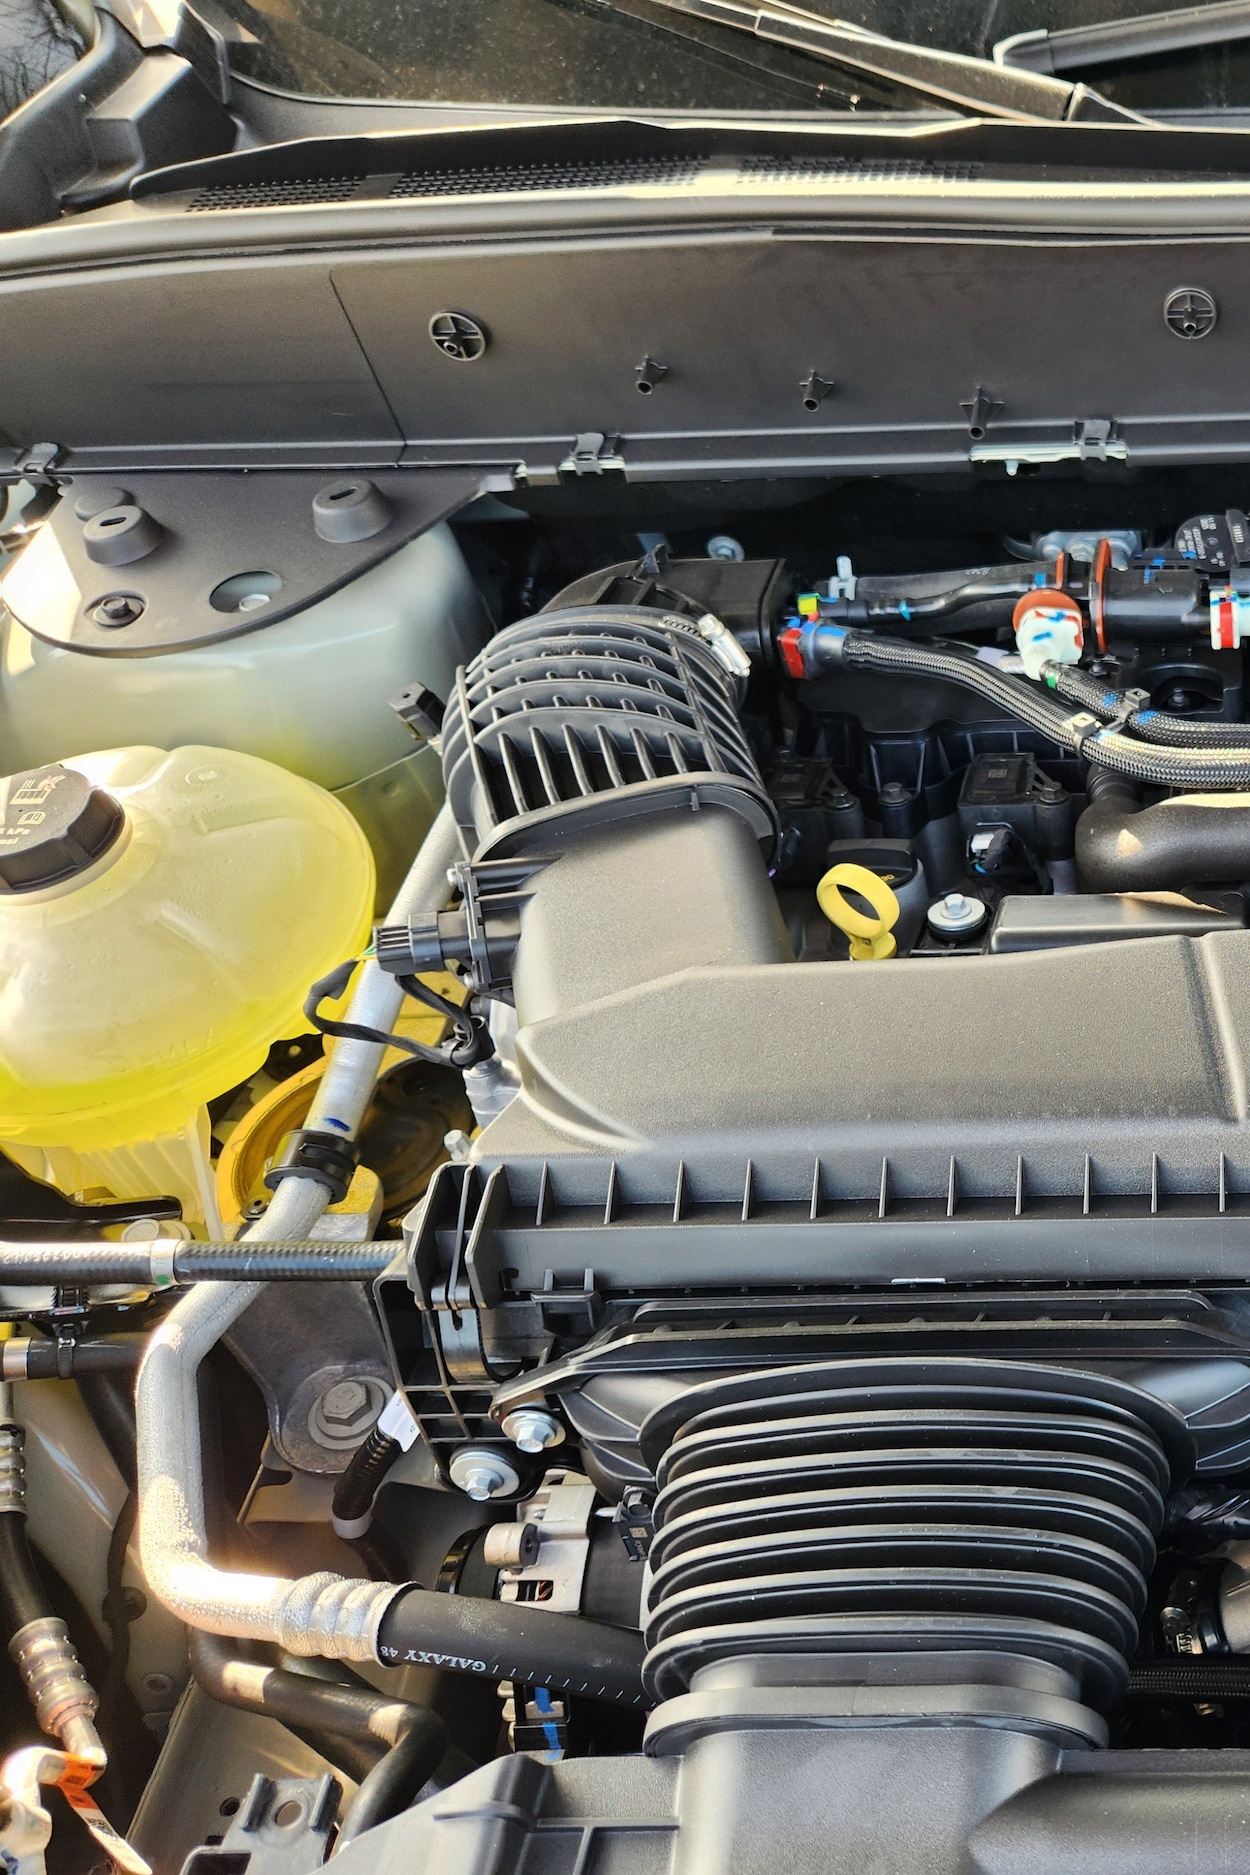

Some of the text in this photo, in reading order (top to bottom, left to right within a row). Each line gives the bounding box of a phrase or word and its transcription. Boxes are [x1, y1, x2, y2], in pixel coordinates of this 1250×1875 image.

[6, 827, 30, 835] kPa
[380, 1645, 487, 1672] GALAXY 48
